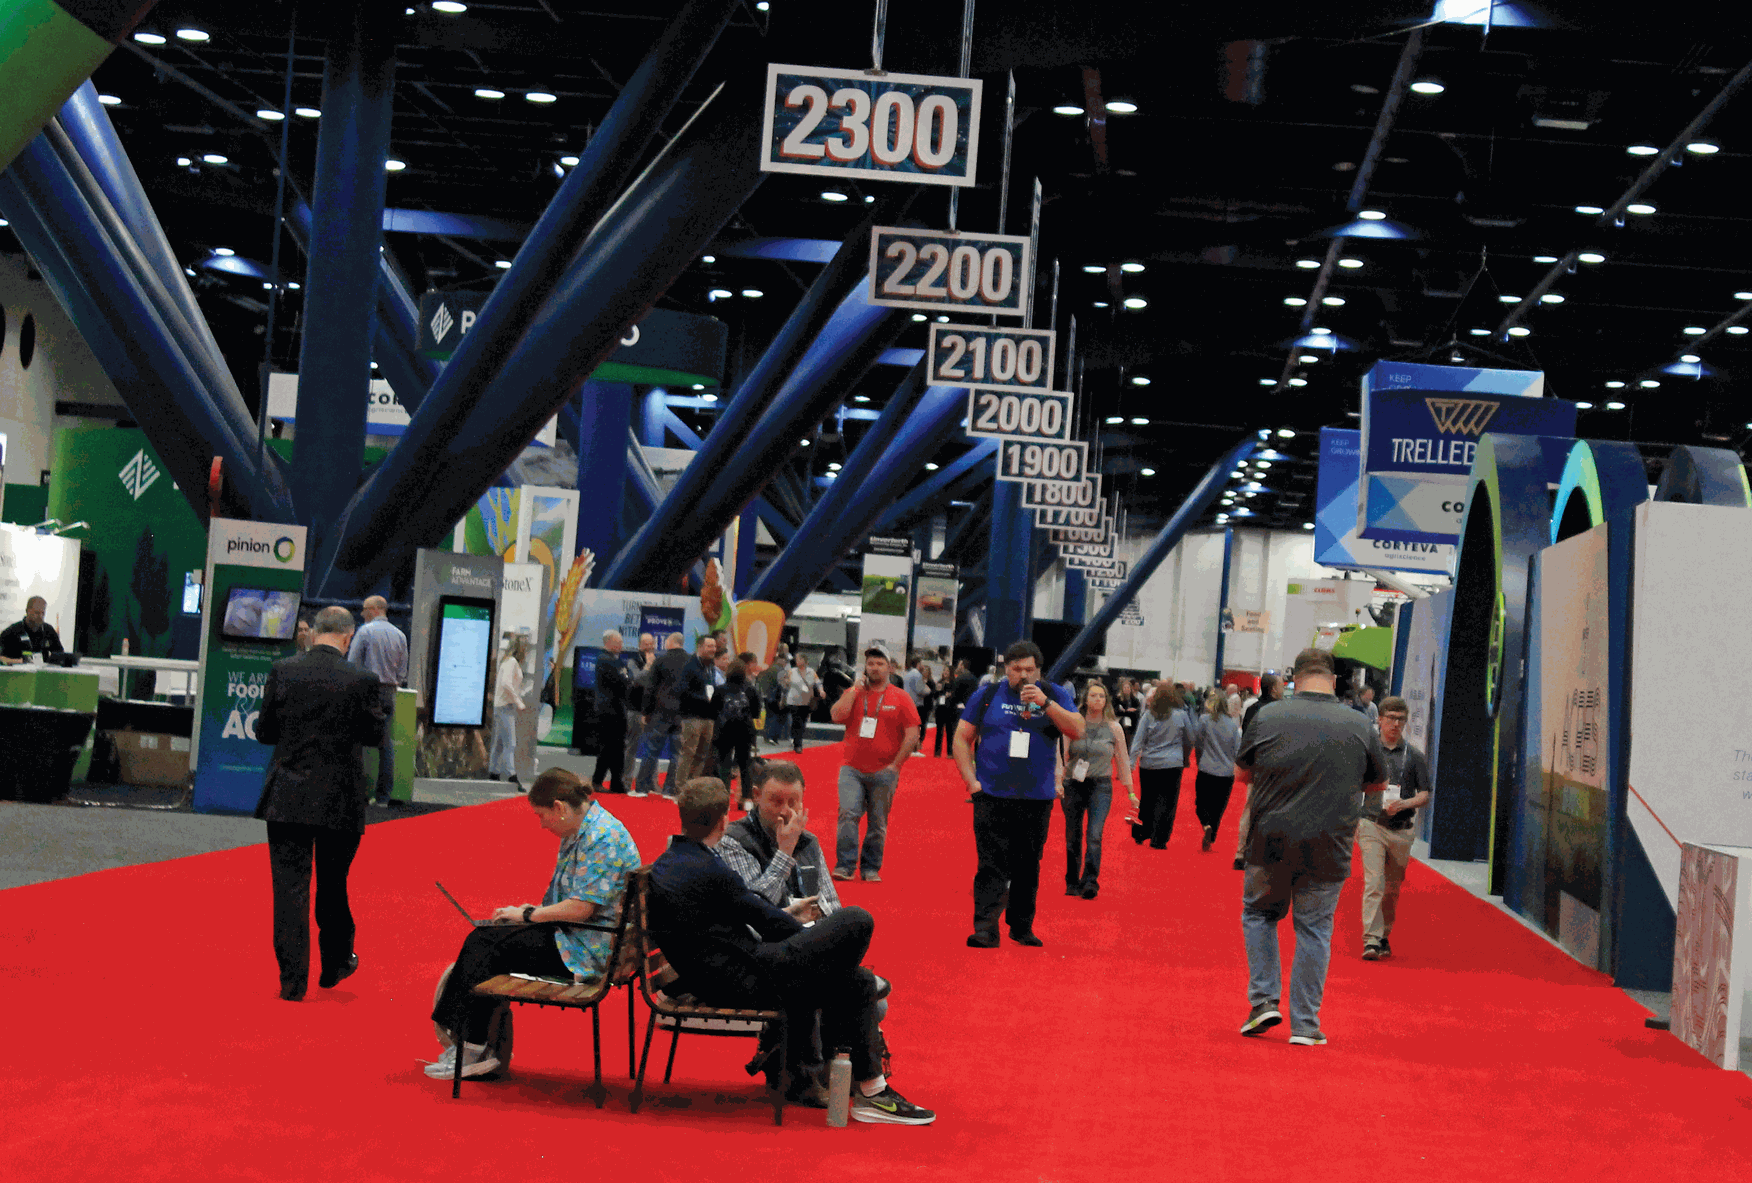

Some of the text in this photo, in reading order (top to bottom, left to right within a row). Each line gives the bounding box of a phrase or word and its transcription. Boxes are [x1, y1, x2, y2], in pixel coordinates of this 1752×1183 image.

[780, 85, 958, 169] 2300
[883, 241, 1013, 303] 2200
[938, 335, 1042, 383] 2100
[1389, 374, 1412, 384] KEEP
[369, 392, 401, 405] COR
[976, 394, 1063, 435] 2000
[1392, 437, 1477, 467] TRELLEB
[1007, 444, 1078, 479] 1900
[1031, 479, 1093, 507] 1800
[1441, 501, 1464, 513] CO
[1045, 508, 1099, 527] 1700
[227, 538, 270, 554] pinion
[1372, 540, 1438, 554] CORTEVA
[452, 567, 472, 576] FARM
[451, 576, 491, 588] ADVANTAGE
[626, 613, 641, 625] BET
[618, 626, 641, 638] NITR
[228, 670, 245, 684] WE
